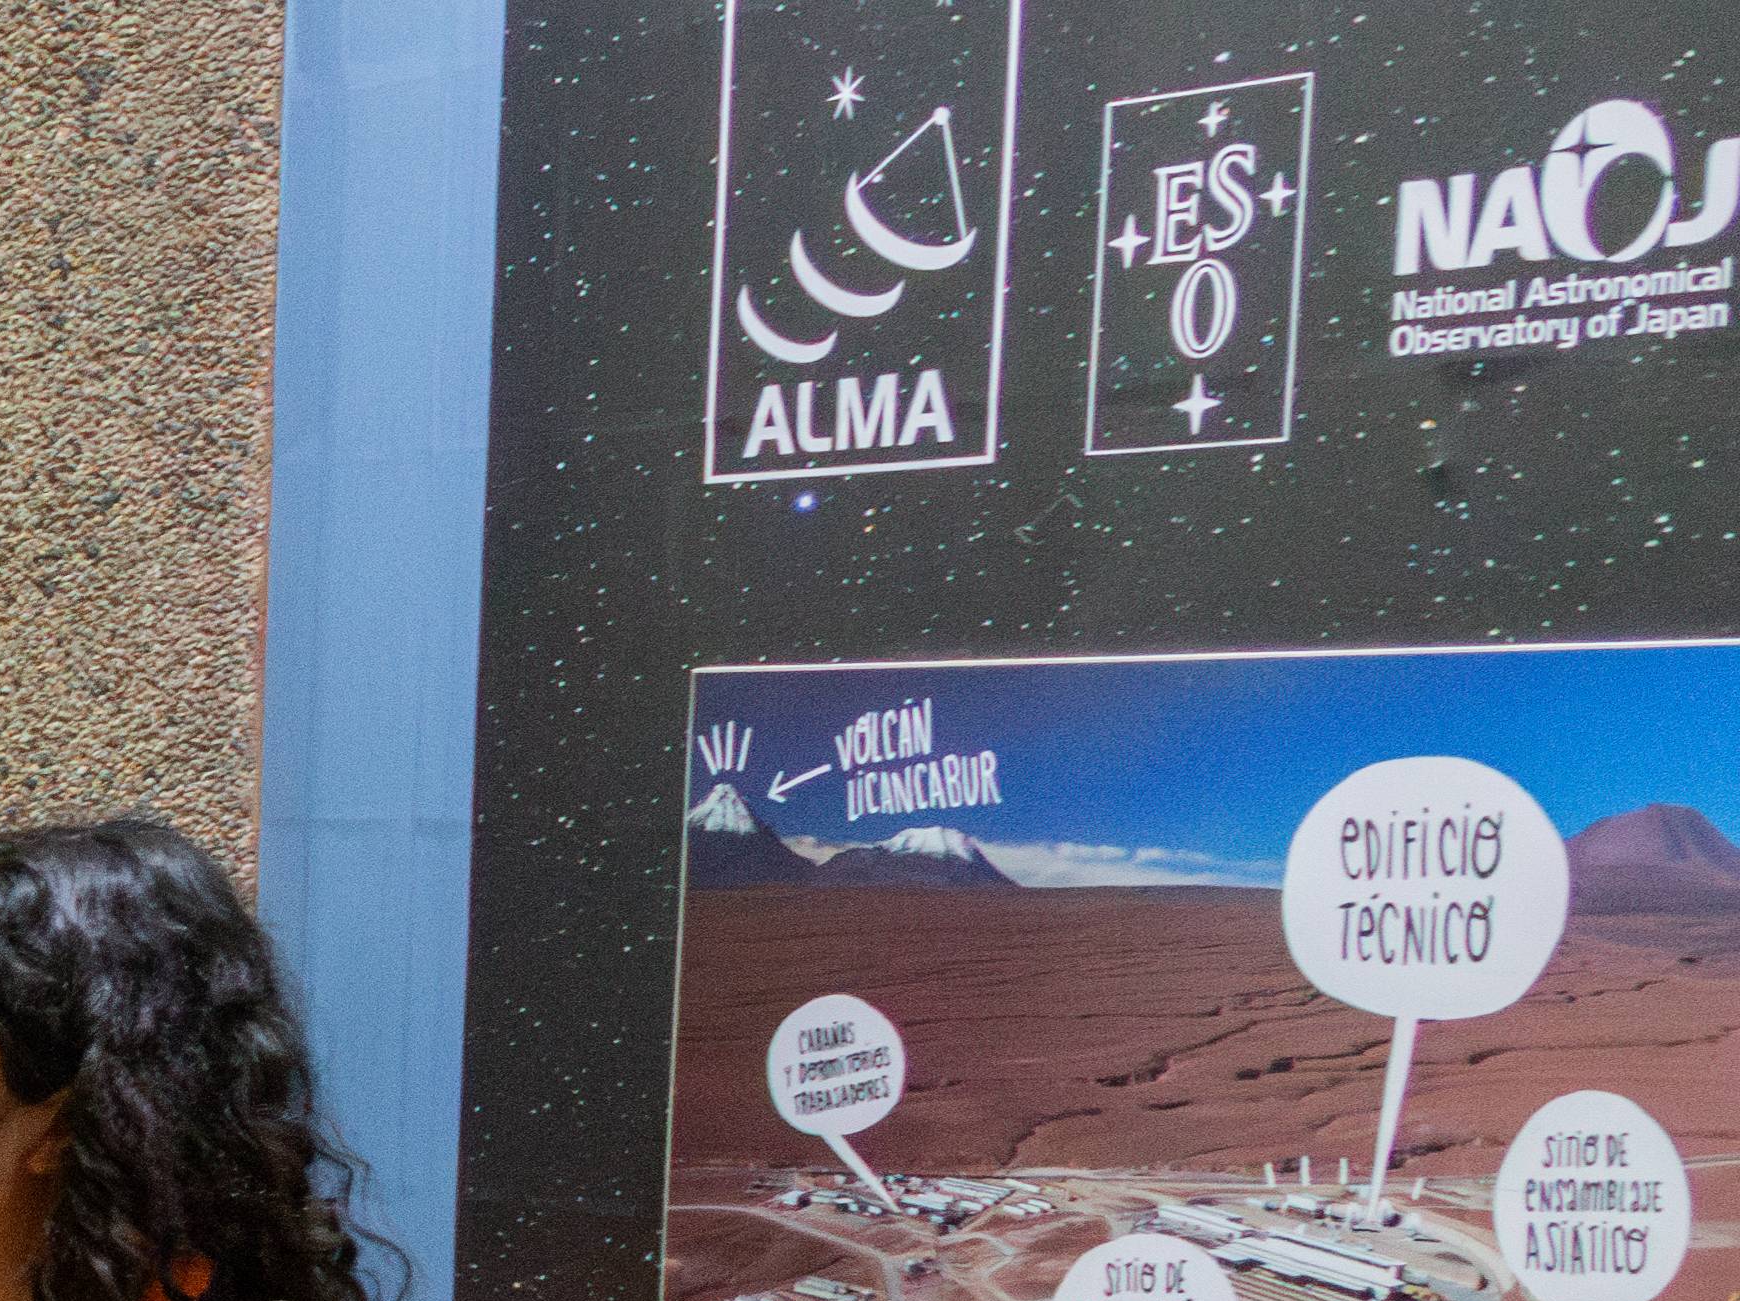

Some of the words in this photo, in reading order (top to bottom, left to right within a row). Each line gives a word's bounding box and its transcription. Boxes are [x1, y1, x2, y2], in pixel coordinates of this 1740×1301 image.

[1392, 279, 1515, 322] National
[1522, 257, 1734, 309] Astronomical
[1389, 317, 1579, 357] Observatory
[1584, 306, 1618, 341] of
[1622, 296, 1731, 337] Japan
[743, 369, 955, 459] ALMA
[834, 698, 932, 772] VOLCÁN
[847, 750, 1002, 821] LICANCABUR
[1340, 803, 1505, 880] EDIFICIO
[1338, 892, 1495, 966] TÉCNICO
[1543, 1131, 1599, 1167] SITIO
[1606, 1132, 1629, 1167] DE
[1525, 1178, 1663, 1212] ENSAMBLAJE
[1104, 1257, 1157, 1296] SITIO
[1165, 1259, 1188, 1294] DE
[1525, 1220, 1650, 1274] ASIÁTICO
